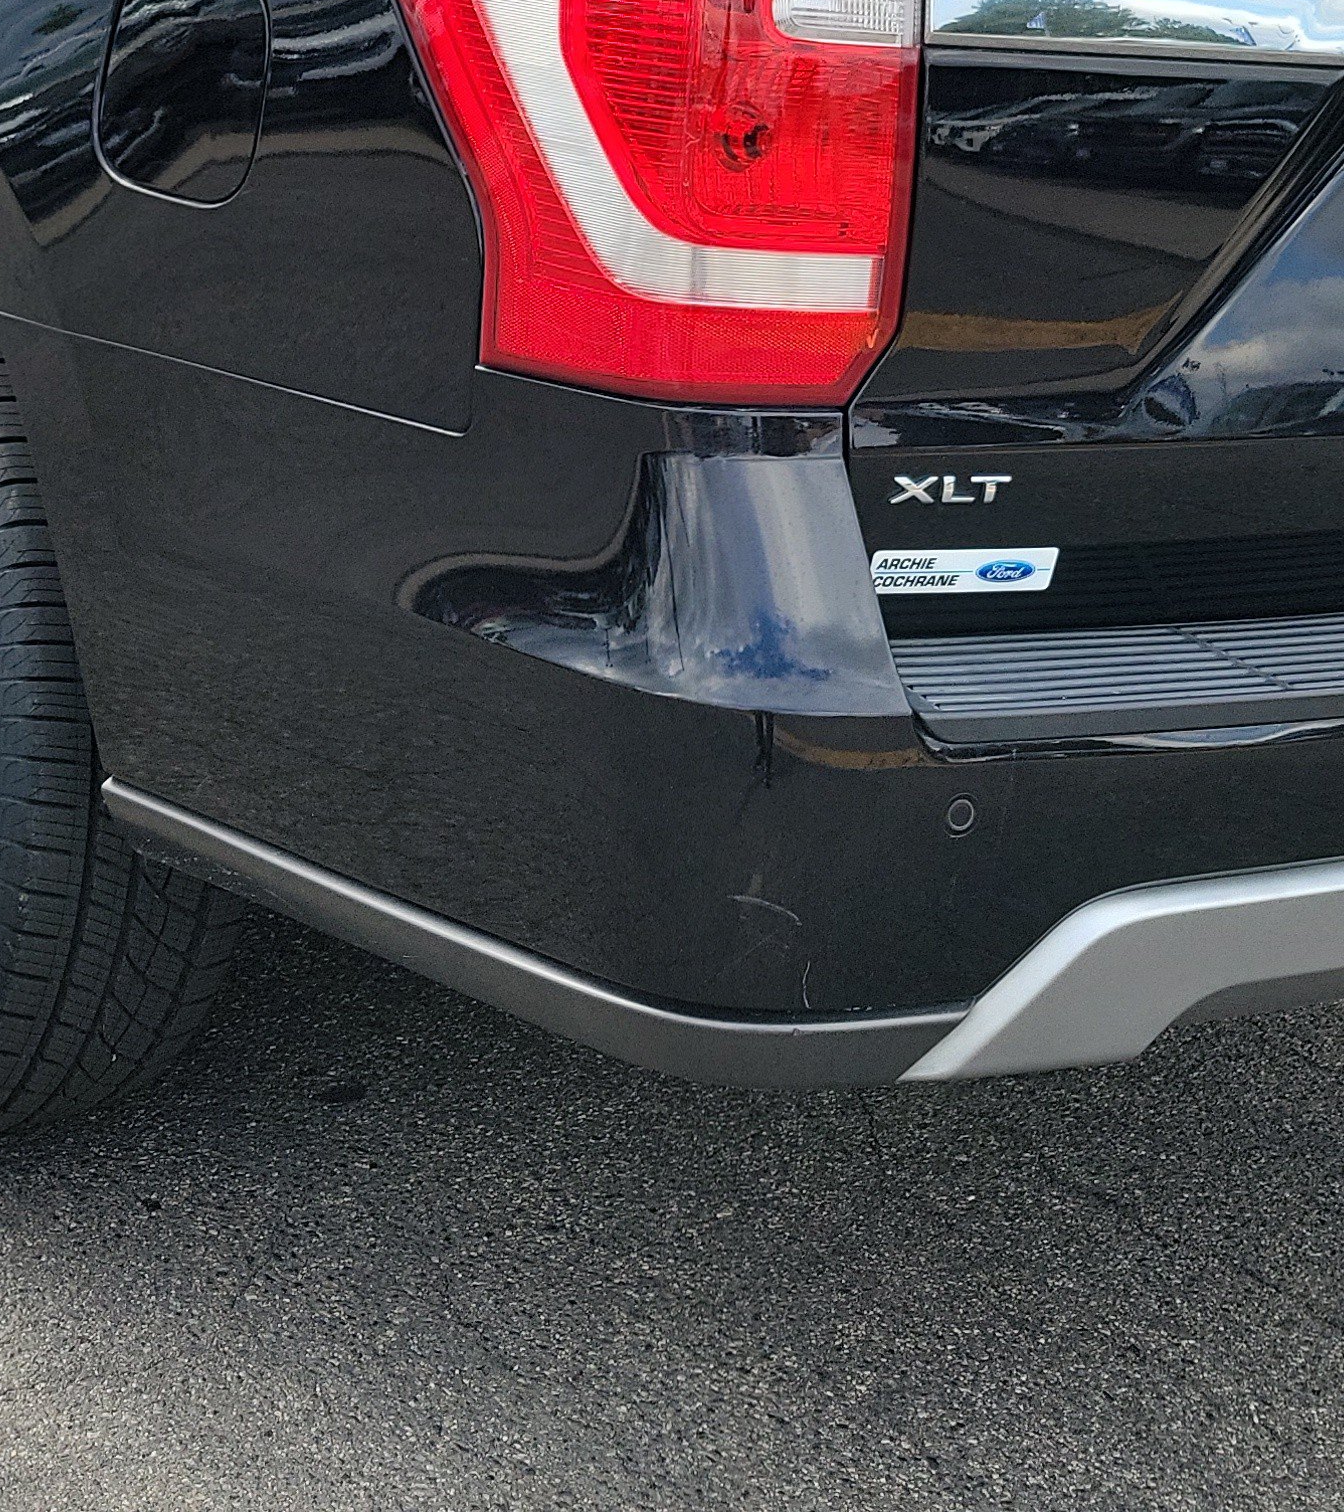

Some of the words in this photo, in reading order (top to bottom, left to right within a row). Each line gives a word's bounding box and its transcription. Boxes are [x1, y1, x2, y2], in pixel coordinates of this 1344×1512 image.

[889, 475, 1013, 504] XLT
[877, 557, 938, 570] ARCHIE
[986, 562, 1024, 579] Ford
[873, 574, 960, 588] COCHRANE
